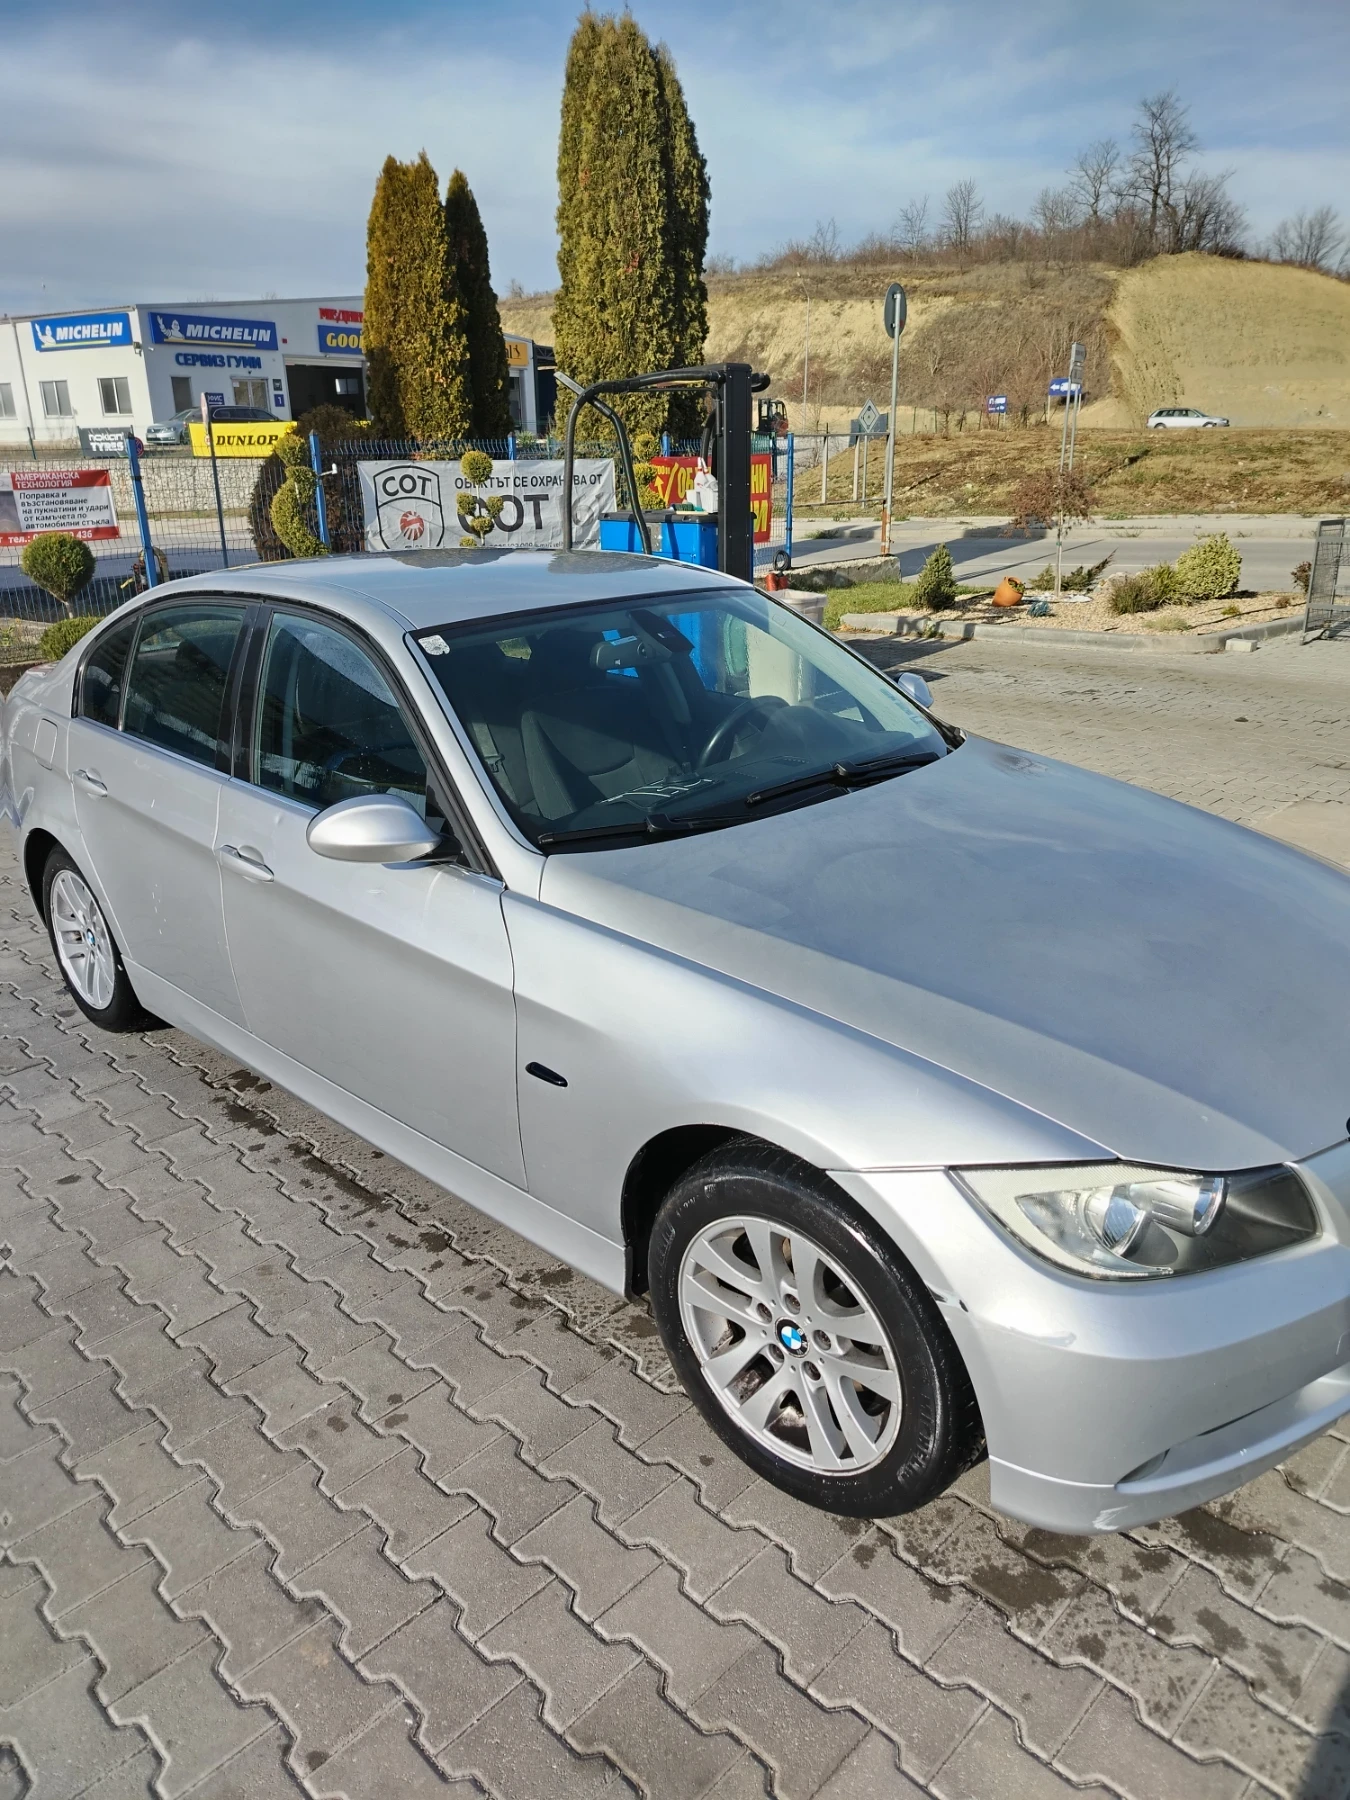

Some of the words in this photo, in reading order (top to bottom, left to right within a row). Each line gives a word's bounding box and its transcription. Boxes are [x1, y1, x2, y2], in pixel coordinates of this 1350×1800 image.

[56, 322, 123, 341] MICHELIN
[186, 324, 271, 342] MICHELIN
[175, 352, 225, 368] СЕРВИЗ
[226, 355, 262, 369] ГУМИ
[216, 434, 279, 446] DUNLOP
[89, 441, 125, 452] TYRES
[15, 471, 80, 481] АМЕРИКАНСКА
[455, 477, 510, 489] ОБКТЪТ
[513, 476, 528, 487] СЕ
[530, 474, 587, 487] ОХРАНВА
[590, 474, 602, 485] ОТ
[16, 480, 73, 489] ТЕХНОЛОГИЯ
[382, 474, 432, 497] СОТ
[19, 492, 60, 500] Поправка
[21, 499, 88, 507] възстановяване
[34, 507, 77, 516] пукнатини
[86, 504, 109, 513] удари
[25, 520, 80, 529] автомобилни
[81, 518, 110, 526] стъкла
[76, 530, 93, 539] 436
